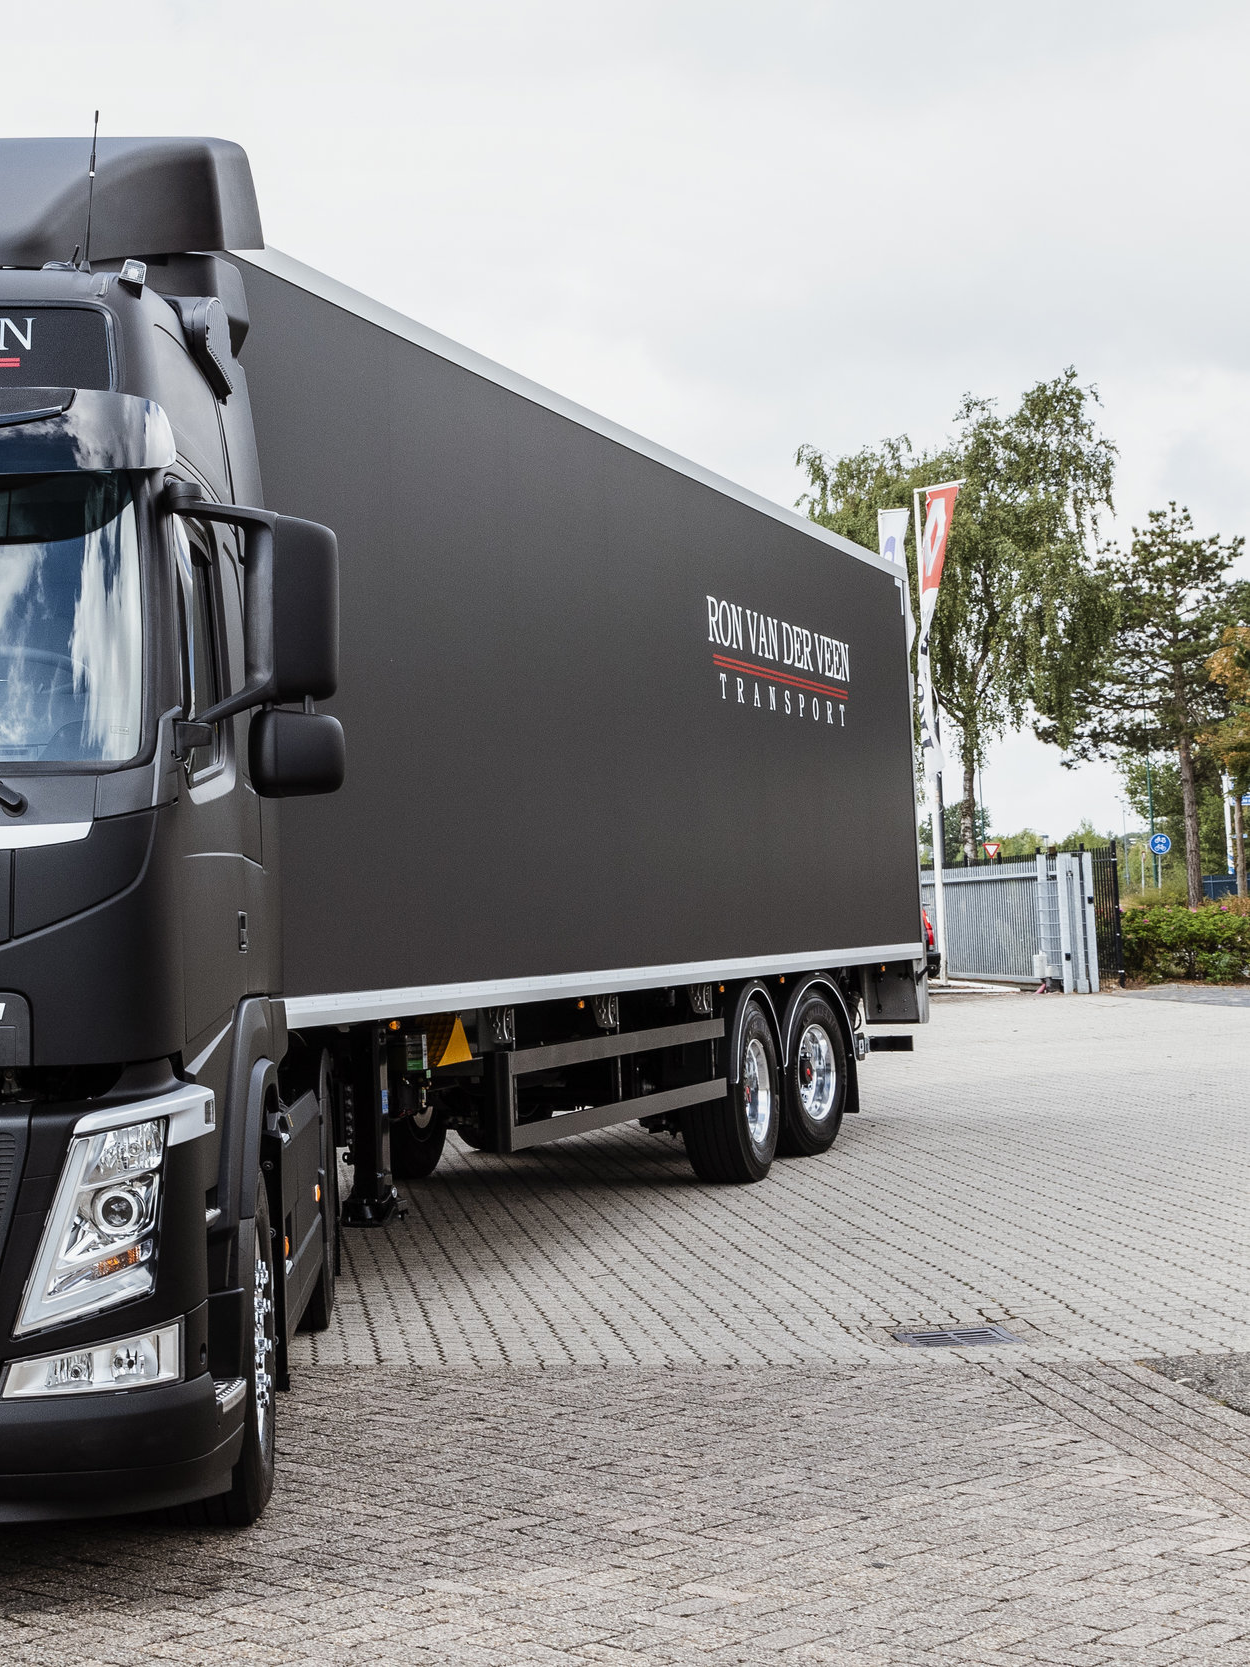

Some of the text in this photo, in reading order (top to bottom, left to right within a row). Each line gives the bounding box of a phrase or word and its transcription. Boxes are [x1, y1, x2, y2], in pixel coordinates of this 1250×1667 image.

[706, 595, 850, 683] RON VAN DER VEEN
[719, 672, 846, 727] TRANSPORT
